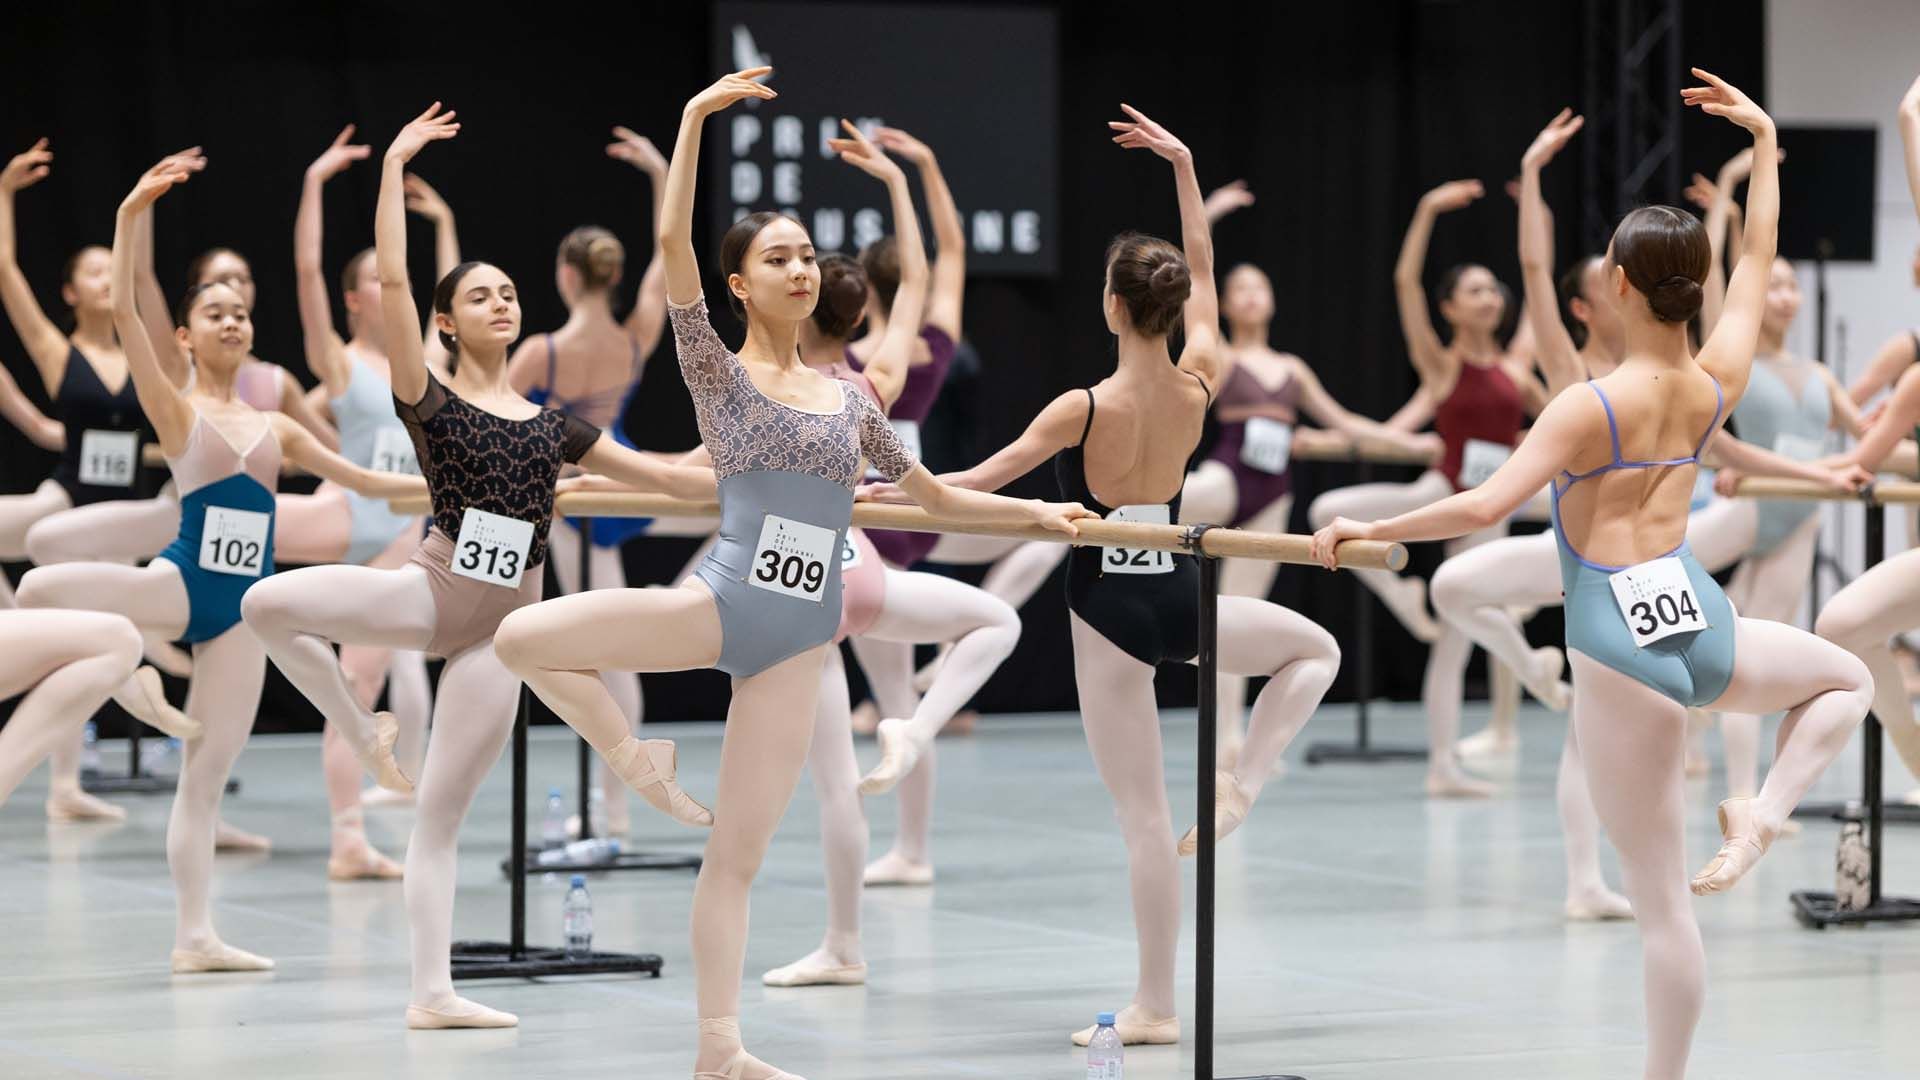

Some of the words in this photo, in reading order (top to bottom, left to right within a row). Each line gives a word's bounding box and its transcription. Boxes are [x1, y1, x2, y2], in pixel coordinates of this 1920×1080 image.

[731, 161, 803, 204] DE
[732, 207, 1041, 254] USNE
[209, 538, 260, 568] 102
[460, 540, 520, 580] 313
[756, 549, 824, 593] 309
[1630, 590, 1698, 636] 304
